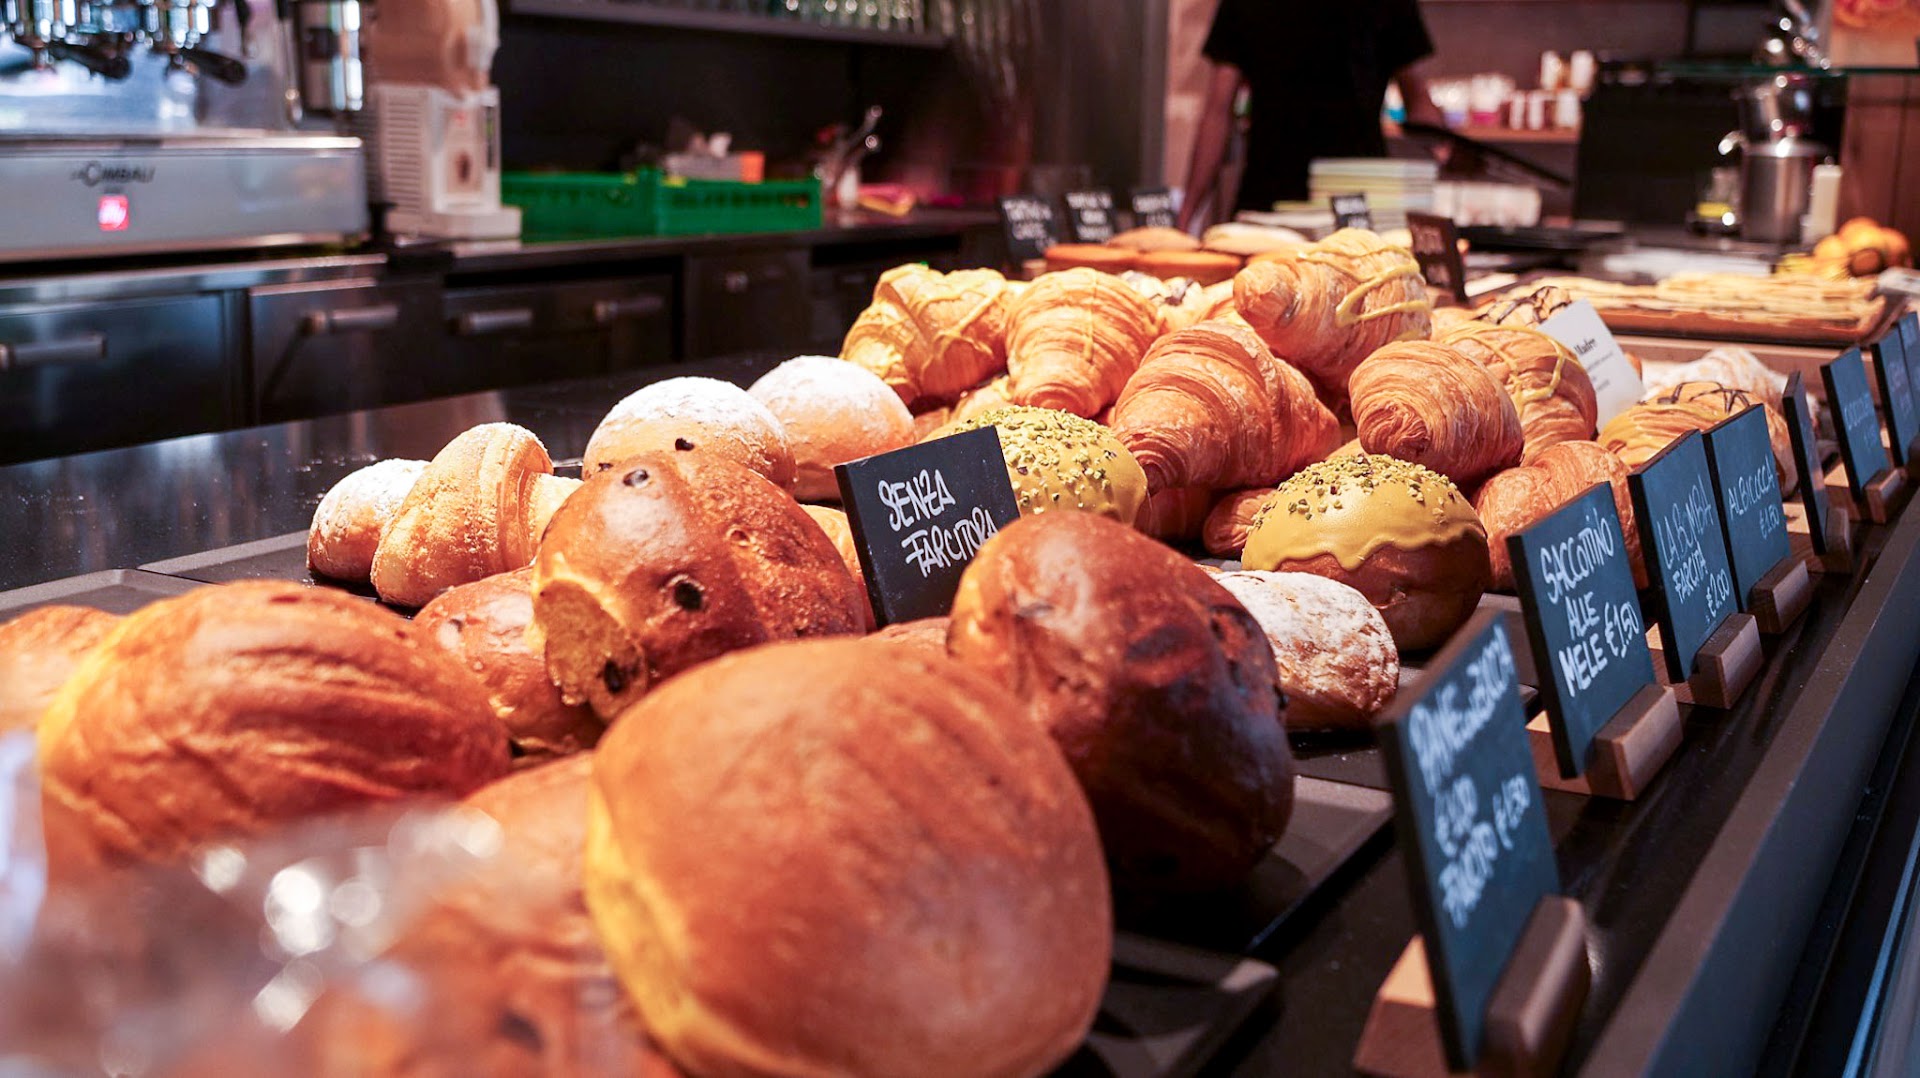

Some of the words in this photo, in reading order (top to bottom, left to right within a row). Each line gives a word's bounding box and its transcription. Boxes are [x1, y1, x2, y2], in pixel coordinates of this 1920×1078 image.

[878, 469, 956, 532] SENZA
[1540, 507, 1614, 605] SACCOTTINO
[1564, 591, 1601, 640] ALLE
[1558, 633, 1608, 698] MELE
